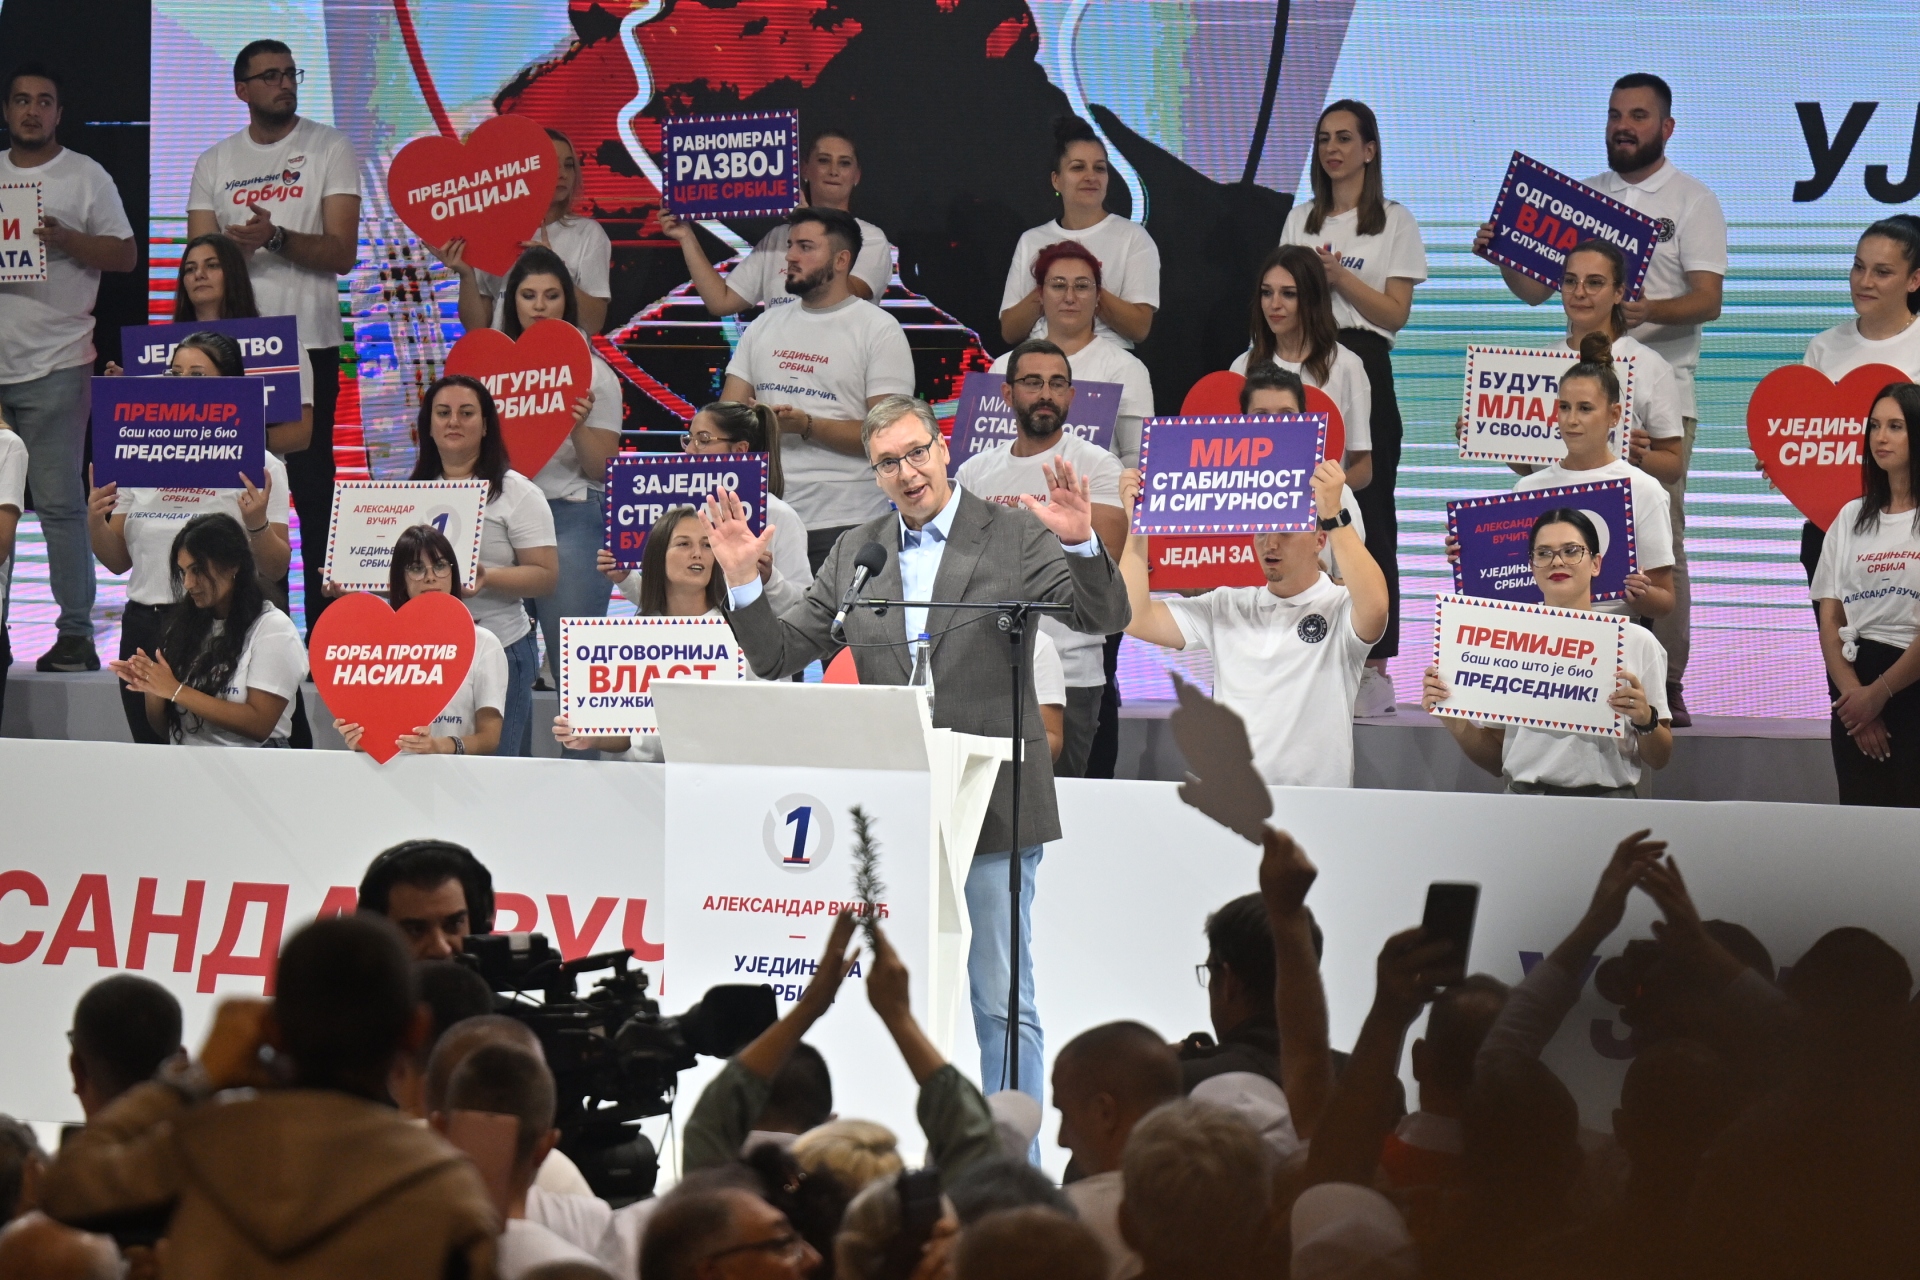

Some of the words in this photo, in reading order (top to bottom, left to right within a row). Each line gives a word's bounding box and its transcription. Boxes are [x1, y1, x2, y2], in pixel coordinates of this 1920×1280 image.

[673, 129, 787, 152] РАВНОМЕРАН
[676, 149, 785, 182] РАЗВОЈ
[407, 169, 493, 205] ПРЕДАЈА
[495, 154, 541, 180] НИЈЕ
[233, 183, 304, 207] Србија
[430, 178, 531, 221] ОПЦИЈА
[674, 183, 718, 204] ЦЕЛЕ
[721, 179, 788, 198] СРБИЈЕ
[1515, 181, 1639, 255] ОДГОВОРНИЈА
[1515, 203, 1596, 251] ВЛА
[1500, 224, 1511, 236] У
[1510, 230, 1566, 265] СЛУЖБИ
[772, 349, 829, 364] УЈЕДИЊЕНА
[779, 361, 814, 374] СРБИЈА
[480, 365, 573, 396] ИГУРНА
[1479, 370, 1558, 395] БУДУЋ
[495, 391, 565, 419] РБИЈА
[805, 388, 837, 401] ВУЧИЋ
[113, 403, 241, 426] ПРЕМИЈЕР,
[1476, 393, 1559, 427] МЛАД
[119, 426, 144, 438] баш
[148, 428, 171, 438] као
[173, 427, 198, 438] што
[200, 427, 212, 440] је
[214, 426, 238, 438] био
[1476, 421, 1486, 435] У
[1489, 423, 1551, 440] СВОЈОЈ
[1767, 417, 1868, 439] УЈЕДИЊ
[115, 444, 243, 462] ПРЕДСЕДНИК!
[1189, 437, 1273, 468] МИР
[1779, 441, 1863, 466] СРБИ
[632, 471, 739, 496] ЗАЈЕДНО
[1152, 469, 1306, 490] СТАБИЛНОСТ
[162, 494, 200, 503] СРБИЈА
[353, 504, 415, 515] АЛЕКСАНДАР
[1149, 494, 1166, 512] И
[1169, 491, 1303, 512] СИГУРНОСТ
[366, 516, 397, 525] ВУЧИЋ
[1474, 516, 1539, 534] АЛЕКСАНД
[1492, 531, 1529, 544] ВУЧИЋ
[349, 546, 395, 556] УЈЕДИЊЕ
[1160, 545, 1225, 568] ЈЕДАН
[1228, 545, 1255, 563] ЗА
[1867, 562, 1906, 573] СРБИЈА
[1494, 576, 1537, 591] СРБИЈА
[1896, 587, 1920, 602] ВУЧИ
[325, 644, 382, 661] БОРБА
[385, 643, 457, 661] ПРОТИВ
[576, 644, 729, 663] ОДГОВОРНИЈА
[1456, 624, 1599, 666] ПРЕМИЈЕР,
[333, 663, 443, 685] НАСИЉА
[1460, 651, 1490, 666] баш
[1493, 657, 1519, 669] као
[1522, 661, 1549, 674] што
[1550, 661, 1565, 677] је
[1567, 664, 1594, 679] био
[1454, 670, 1599, 703] ПРЕДСЕДНИК!
[577, 696, 586, 708] У
[589, 696, 654, 708] СЛУЖБИ
[783, 805, 812, 867] 1
[702, 895, 825, 917] АЛЕКСАНДАР
[734, 955, 862, 978] УЈЕДИЊА
